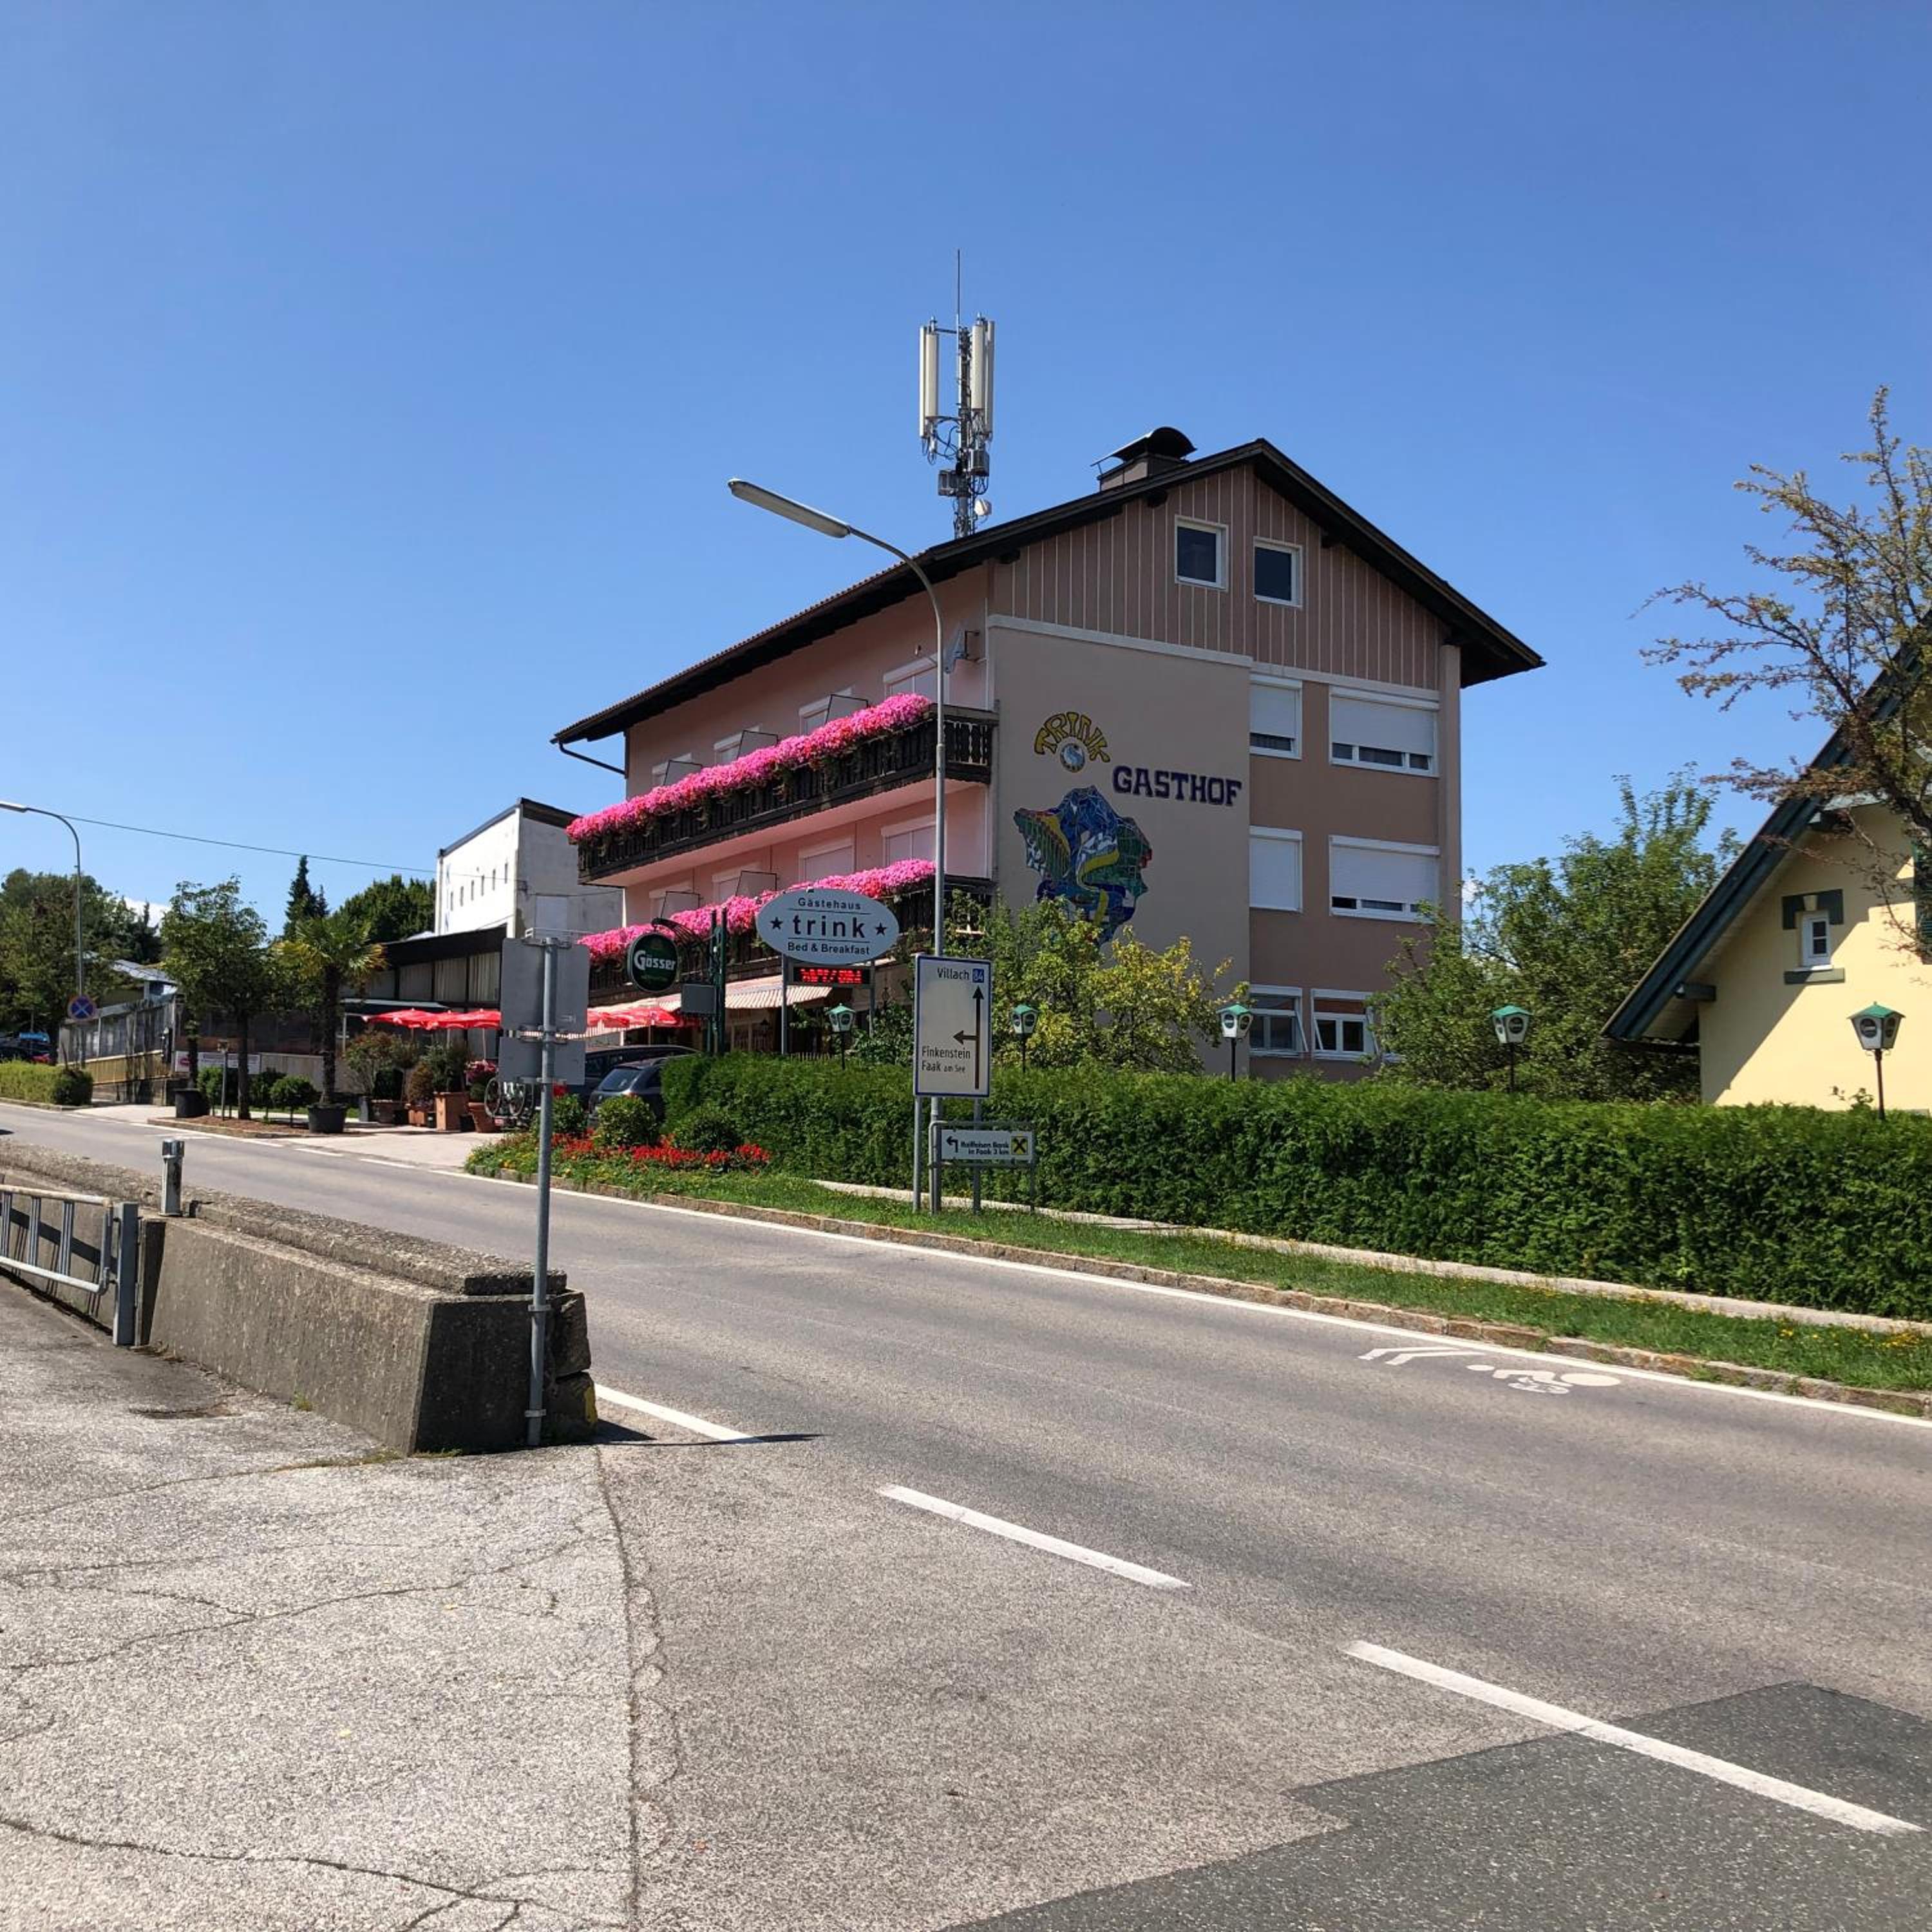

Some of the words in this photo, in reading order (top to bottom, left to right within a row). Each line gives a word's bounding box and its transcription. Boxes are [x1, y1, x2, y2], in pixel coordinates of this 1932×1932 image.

[1034, 712, 1110, 762] TRINK
[1113, 765, 1242, 806] GASTHOF
[793, 914, 866, 938] trink
[788, 942, 808, 951] Bed
[811, 943, 818, 952] &
[821, 943, 869, 954] Breakfast
[634, 950, 676, 971] Gösser
[937, 967, 969, 980] Villach
[922, 1046, 971, 1059] Finkenstein
[922, 1061, 941, 1072] Faak
[955, 1065, 965, 1073] See
